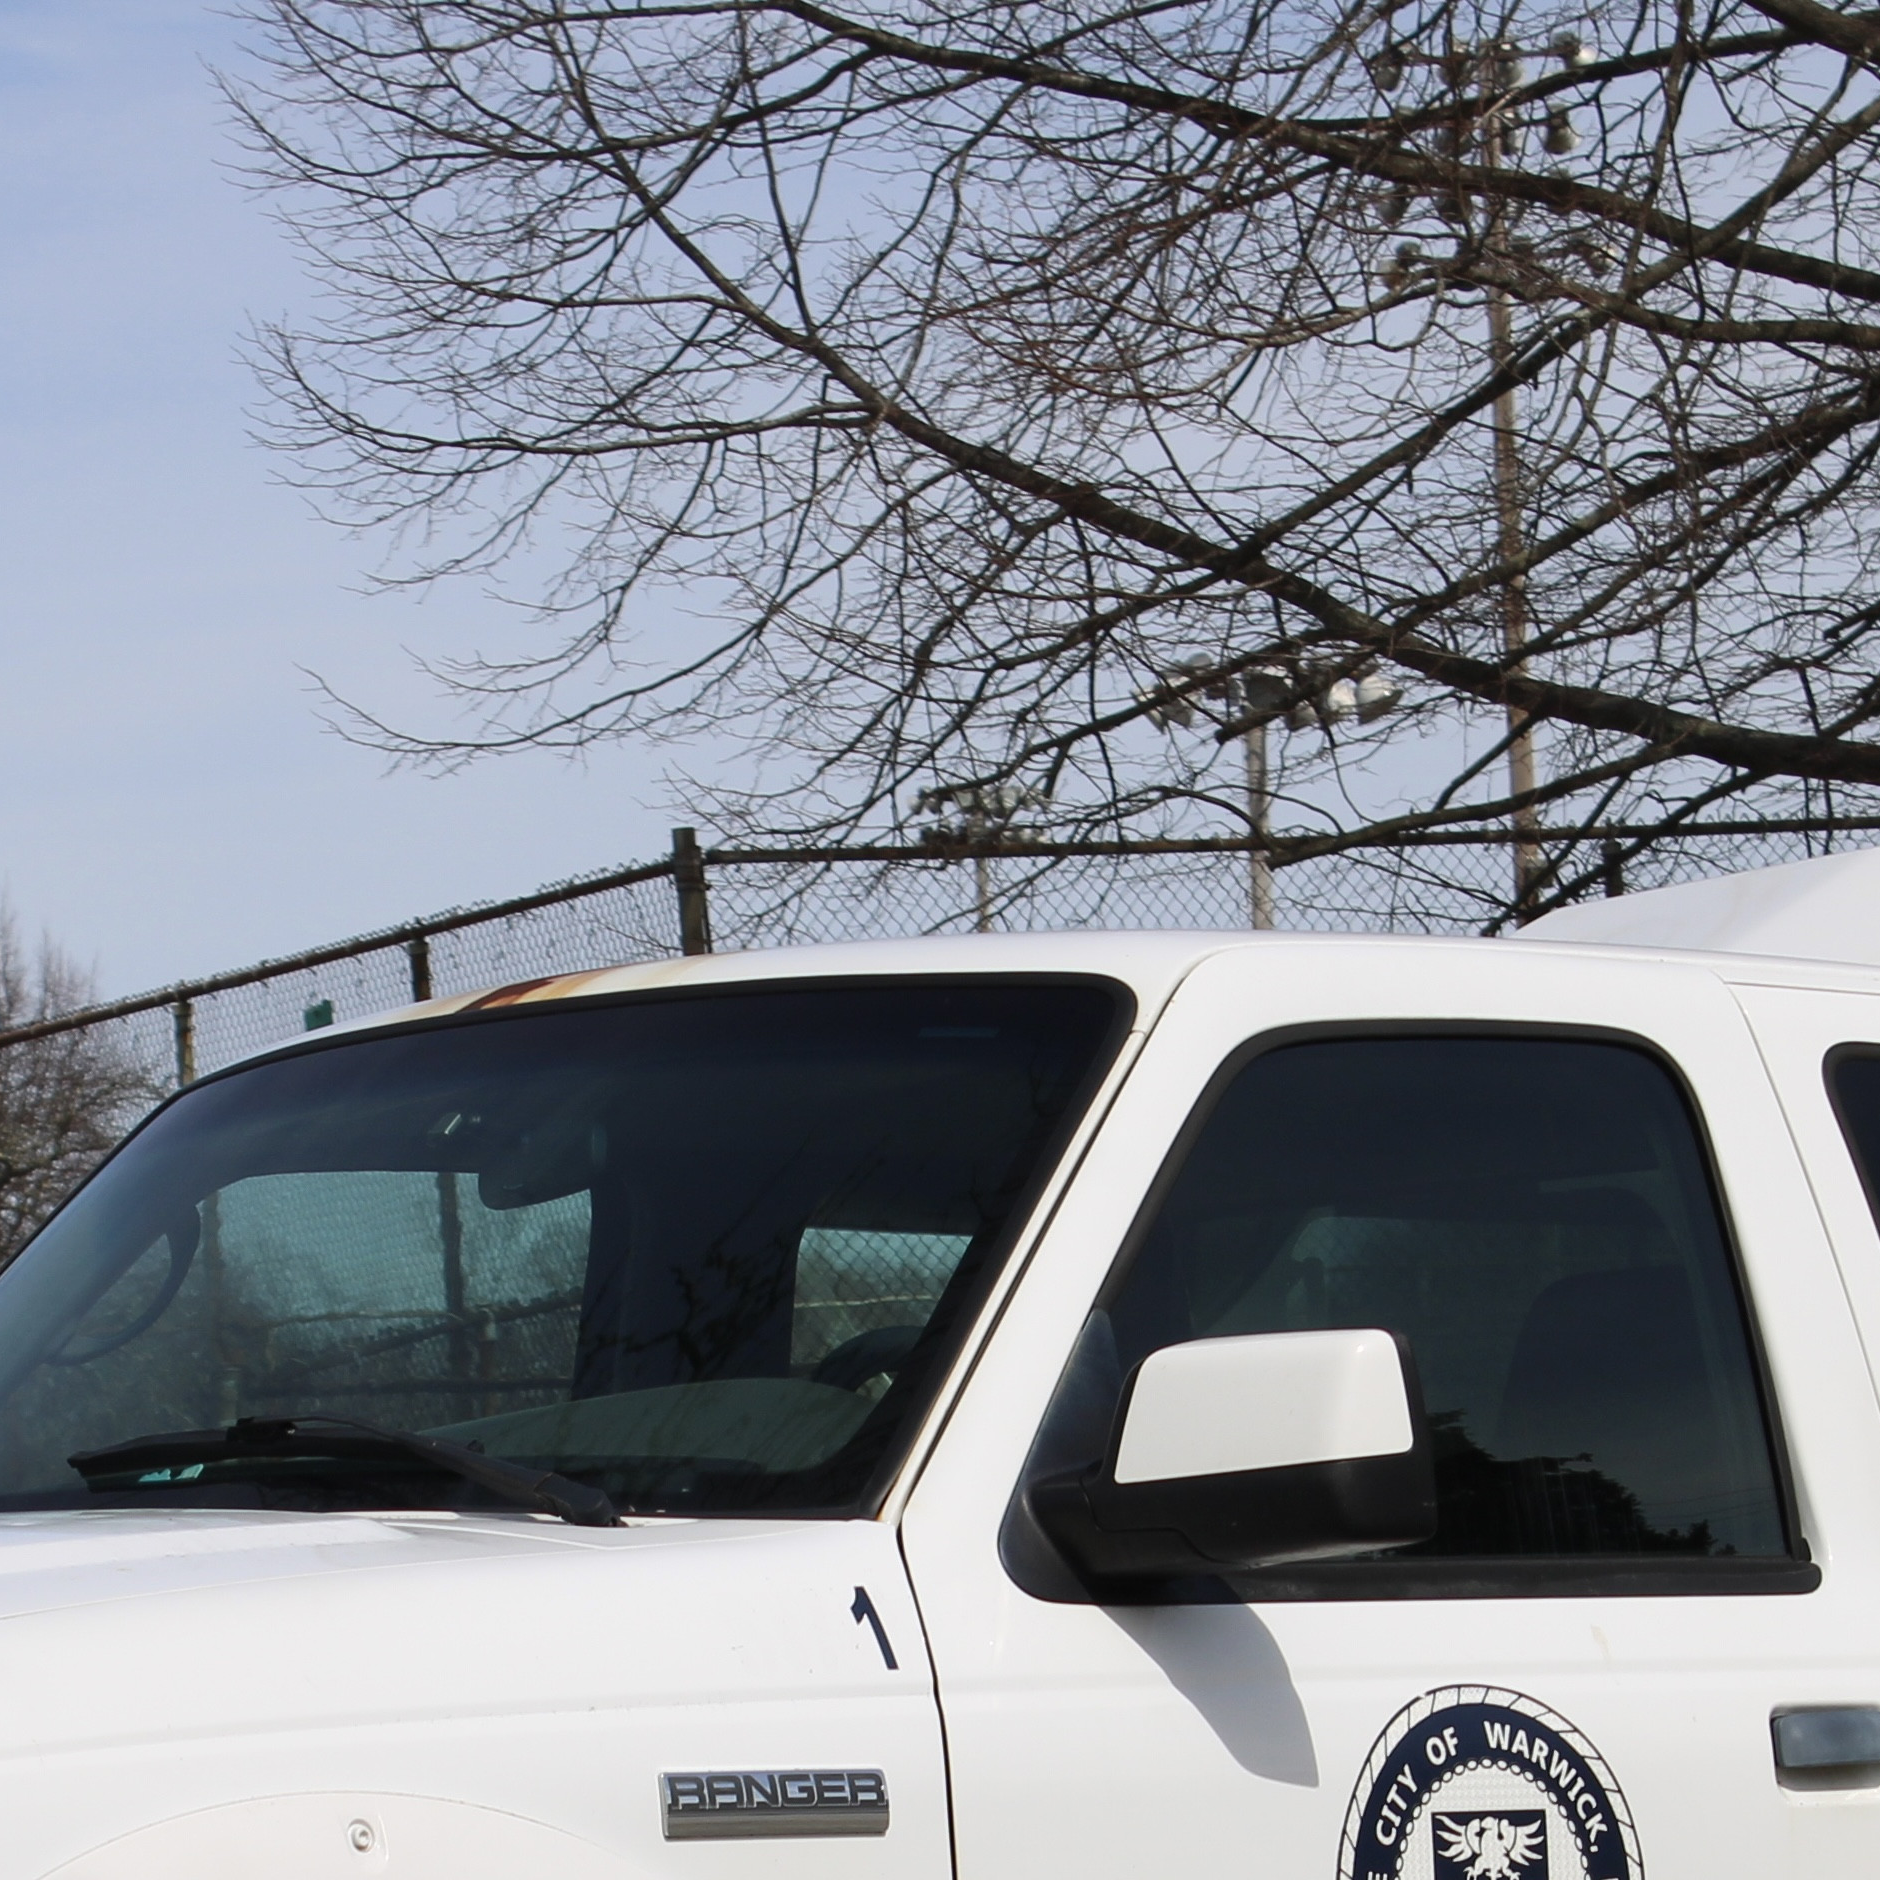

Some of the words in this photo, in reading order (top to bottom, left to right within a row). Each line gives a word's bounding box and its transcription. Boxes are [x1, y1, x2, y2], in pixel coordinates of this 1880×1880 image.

[669, 1773, 887, 1810] RANGER
[1375, 1764, 1420, 1846] CITY
[1425, 1726, 1460, 1766] OF
[1483, 1720, 1609, 1853] WARWICK,
